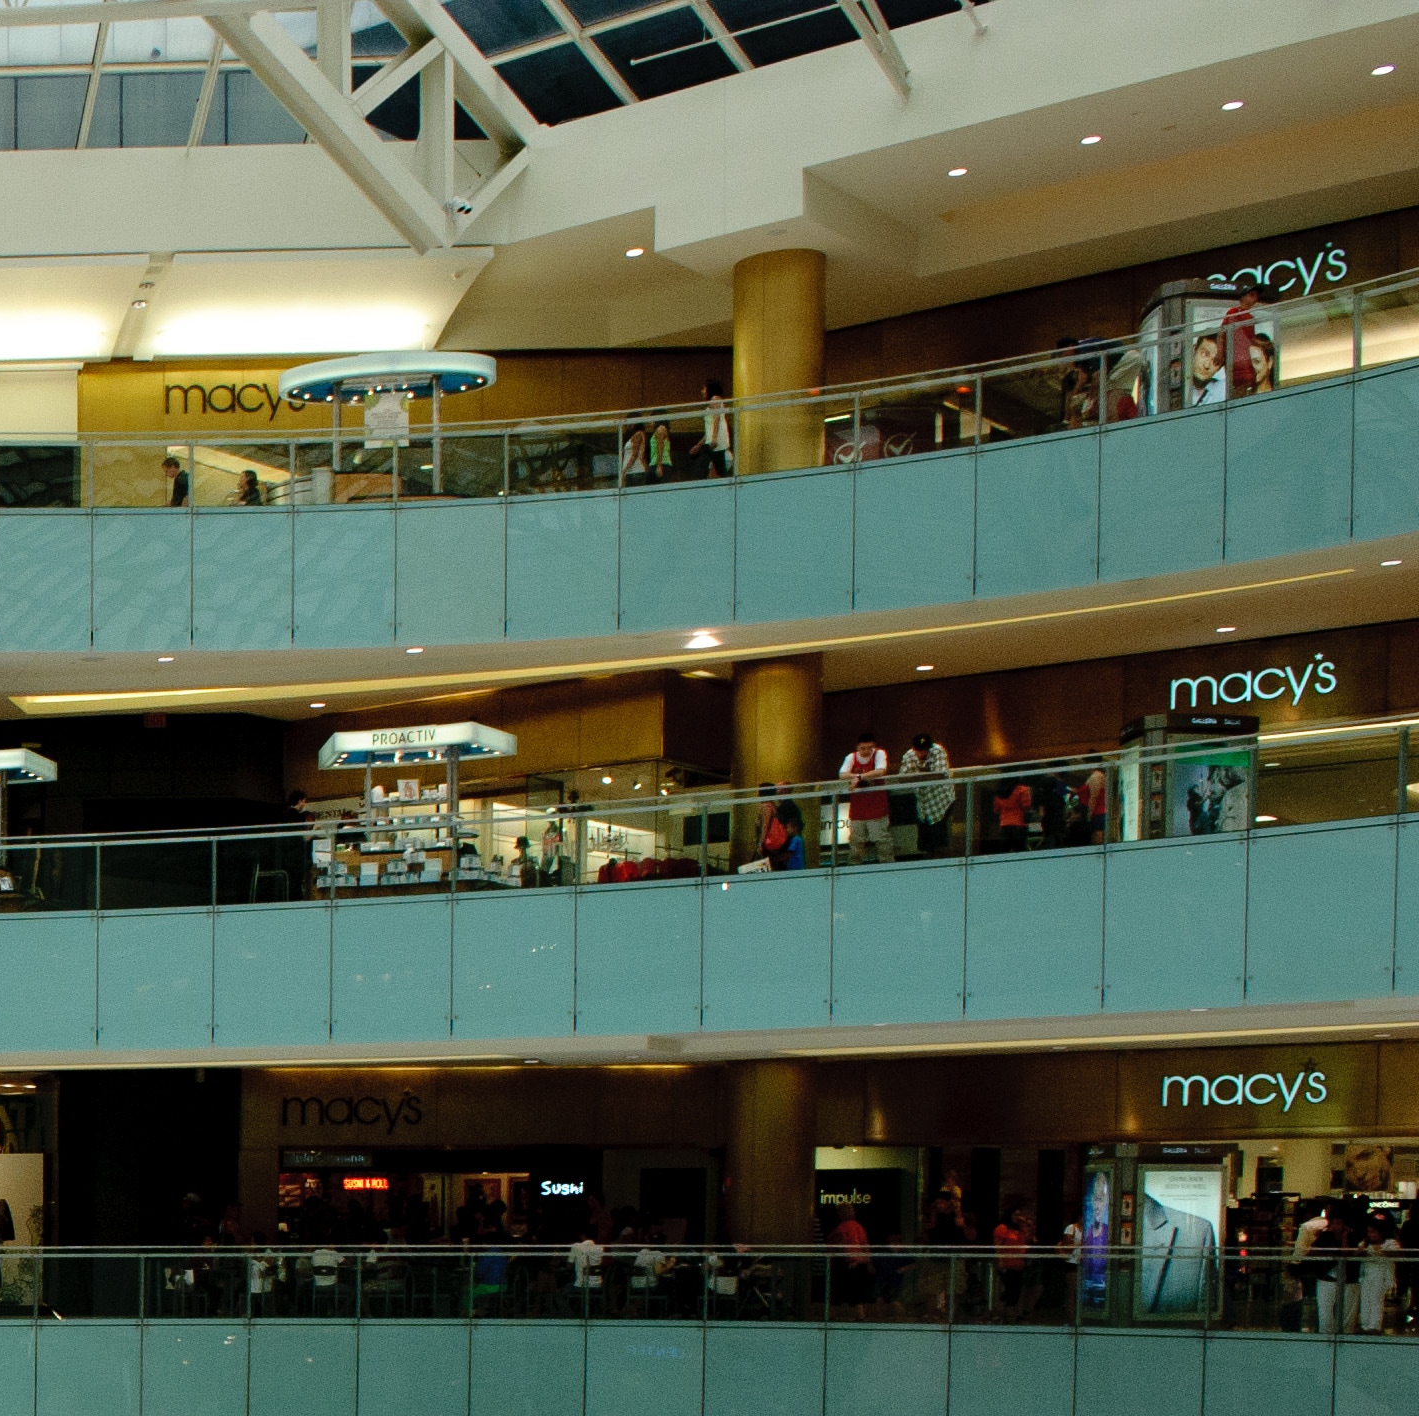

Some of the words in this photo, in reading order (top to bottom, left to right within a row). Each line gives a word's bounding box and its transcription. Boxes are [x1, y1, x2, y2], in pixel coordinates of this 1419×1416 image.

[1207, 242, 1348, 295] acy's
[165, 383, 307, 421] macy
[1171, 653, 1337, 710] macy's
[372, 729, 436, 746] PROACTIV
[282, 1091, 423, 1136] macy's
[541, 1180, 584, 1196] Sushi
[819, 1187, 872, 1206] impulse
